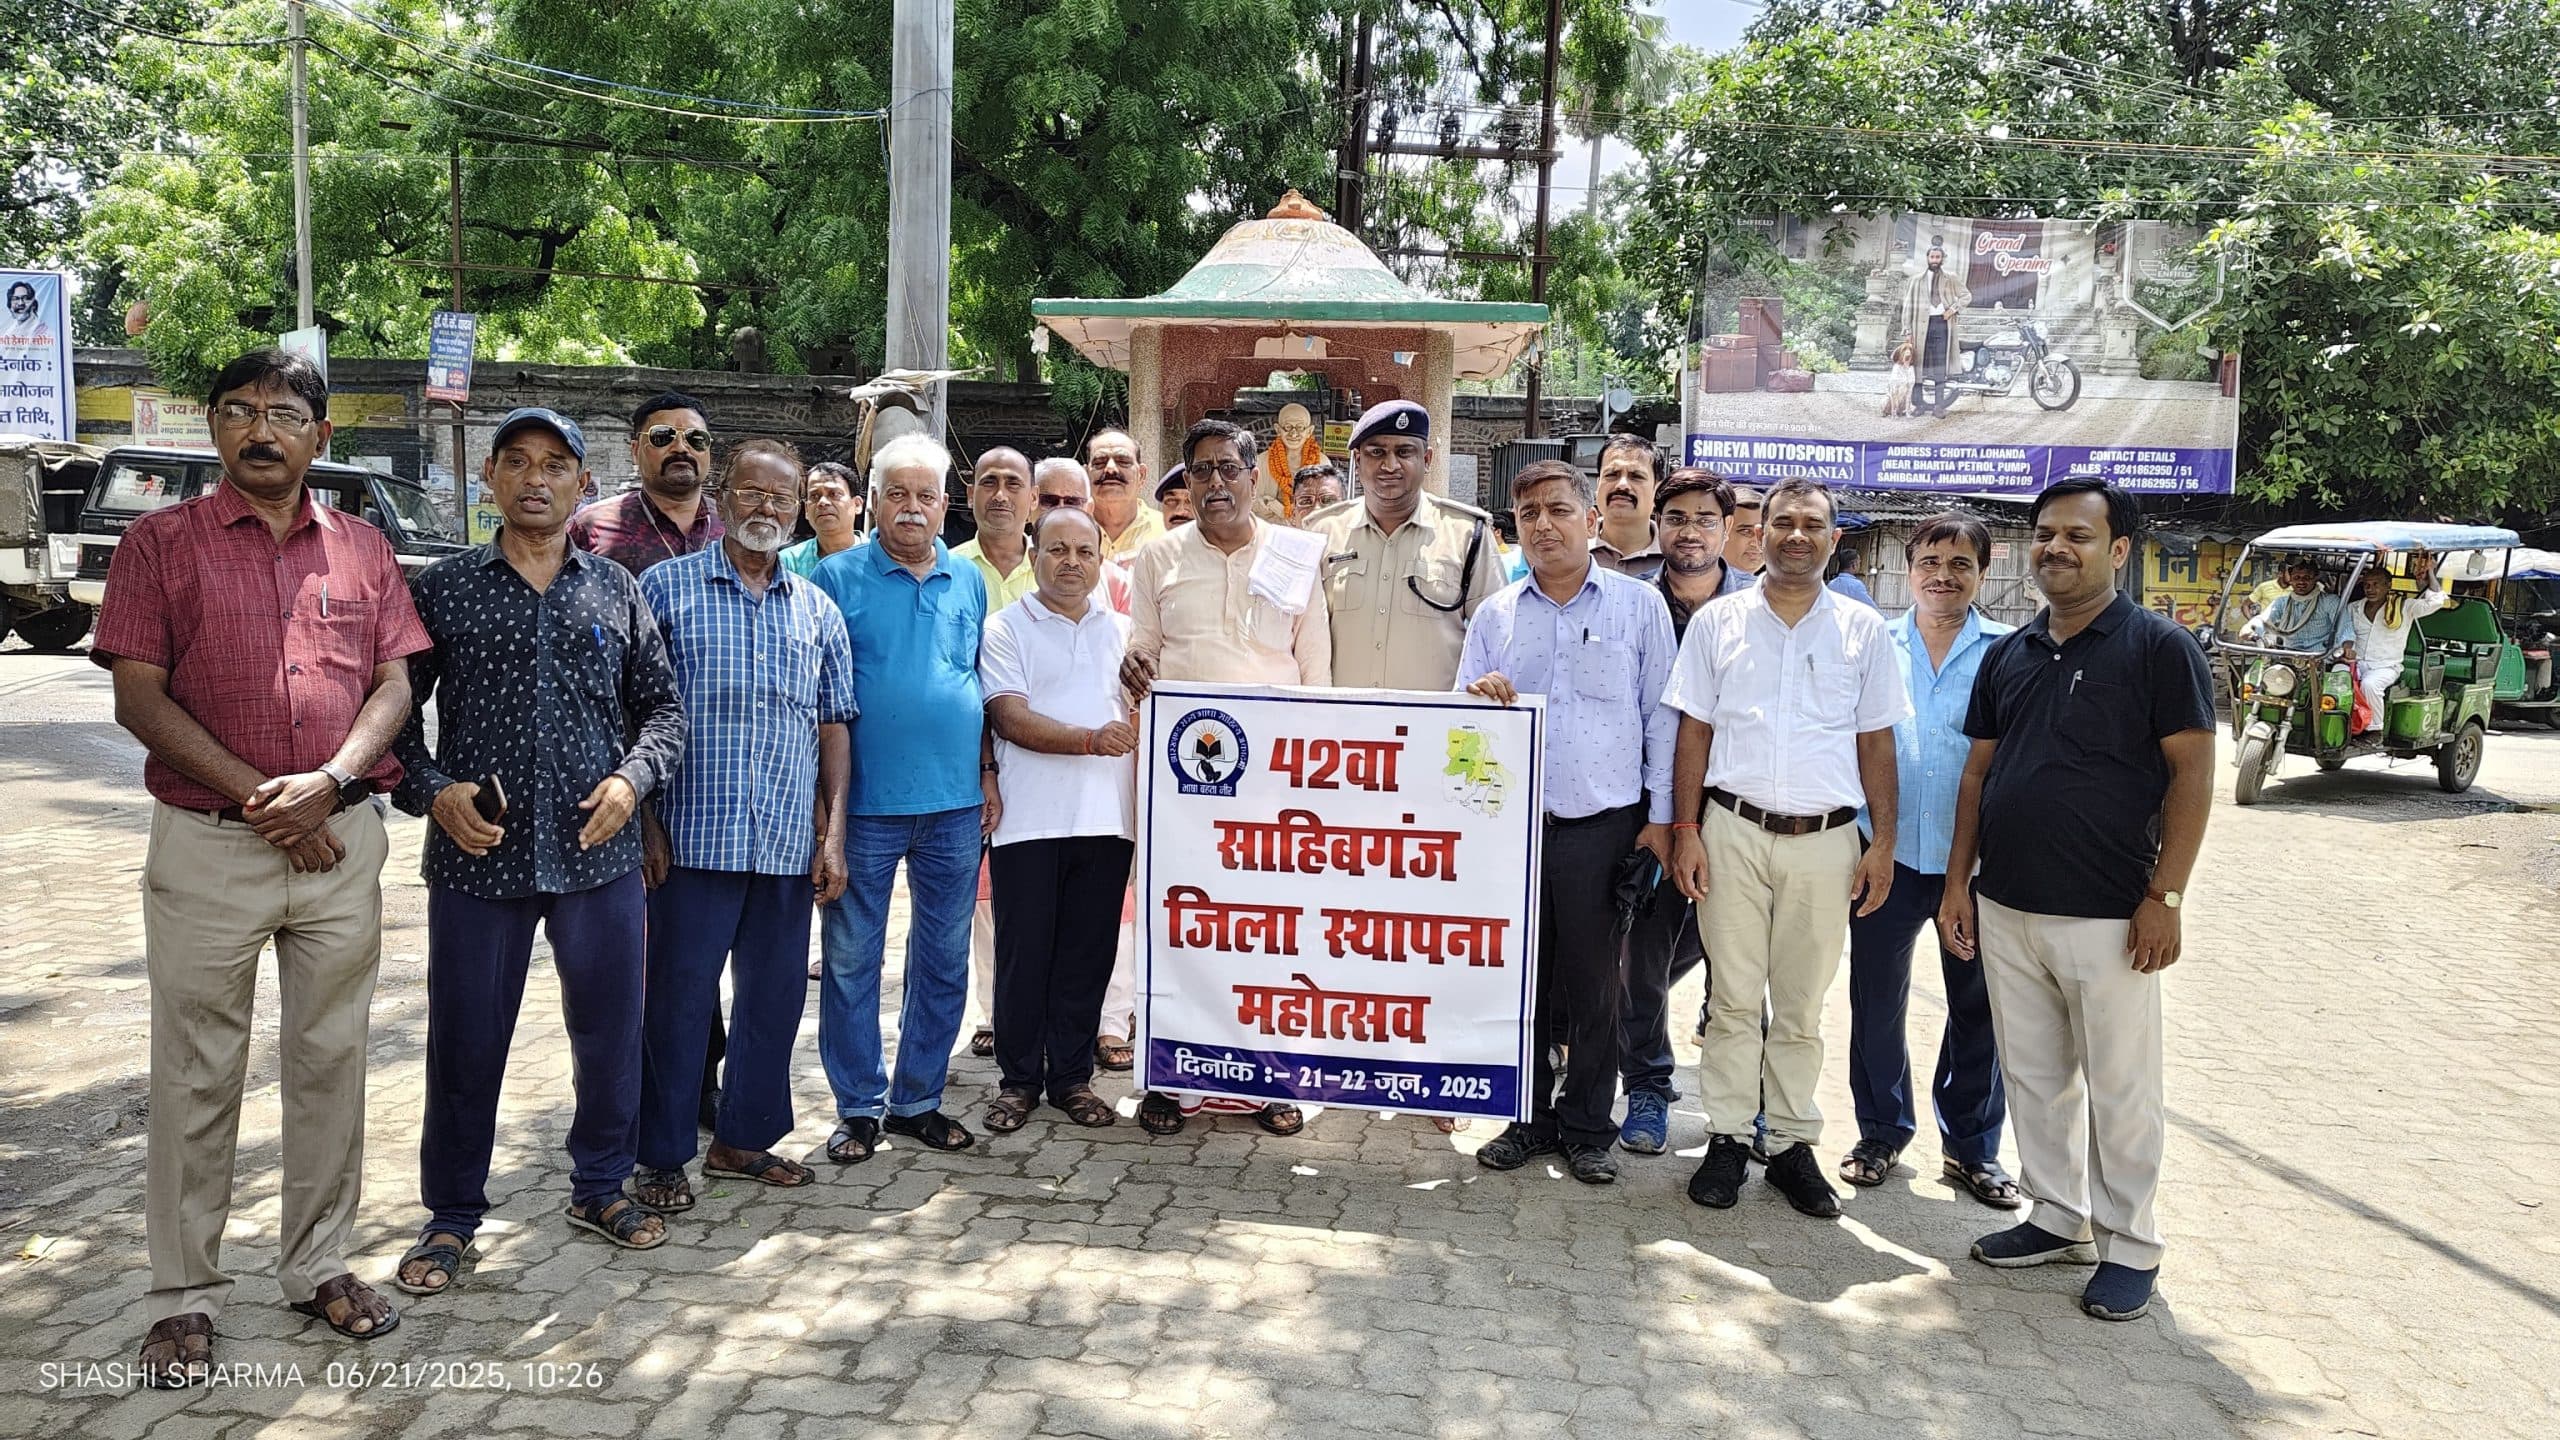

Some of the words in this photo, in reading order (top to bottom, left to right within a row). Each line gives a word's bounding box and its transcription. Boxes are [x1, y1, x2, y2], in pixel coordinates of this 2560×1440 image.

[1975, 231, 2026, 255] Grand
[1993, 252, 2054, 277] Opening
[1693, 440, 1750, 458] SHREYA
[1753, 442, 1855, 463] MOTOSPORTS
[1887, 446, 1932, 458] ADDRESS
[1939, 447, 1978, 459] CHOTTA
[1980, 448, 2026, 460] LOHANDA
[2089, 450, 2136, 462] CONTACT
[2137, 451, 2177, 463] DETAILS
[1757, 463, 1854, 480] KHUDANIA)
[1881, 459, 1911, 471] (NEAR
[1913, 460, 1956, 471] BHARTIA
[1958, 461, 1996, 473] PETROL
[1997, 462, 2031, 474] PUMP)
[2069, 463, 2102, 474] SALES
[2113, 464, 2172, 476] 9241862950
[2180, 466, 2193, 477] 51
[1877, 471, 1935, 485] SAHIBGANJ,
[1936, 472, 2034, 486] JHARKHAND-816109
[2117, 477, 2177, 489] 9241862955
[2185, 478, 2199, 489] 56
[1269, 726, 1408, 792] 42वां
[1213, 809, 1462, 882] साहिबगंज
[1163, 885, 1304, 956] जिला
[1320, 907, 1510, 968] स्थापना
[1232, 973, 1431, 1044] महोत्सव
[1174, 1048, 1256, 1083] दिनांक
[1374, 1071, 1431, 1102] जून,
[1439, 1075, 1492, 1101] 2025
